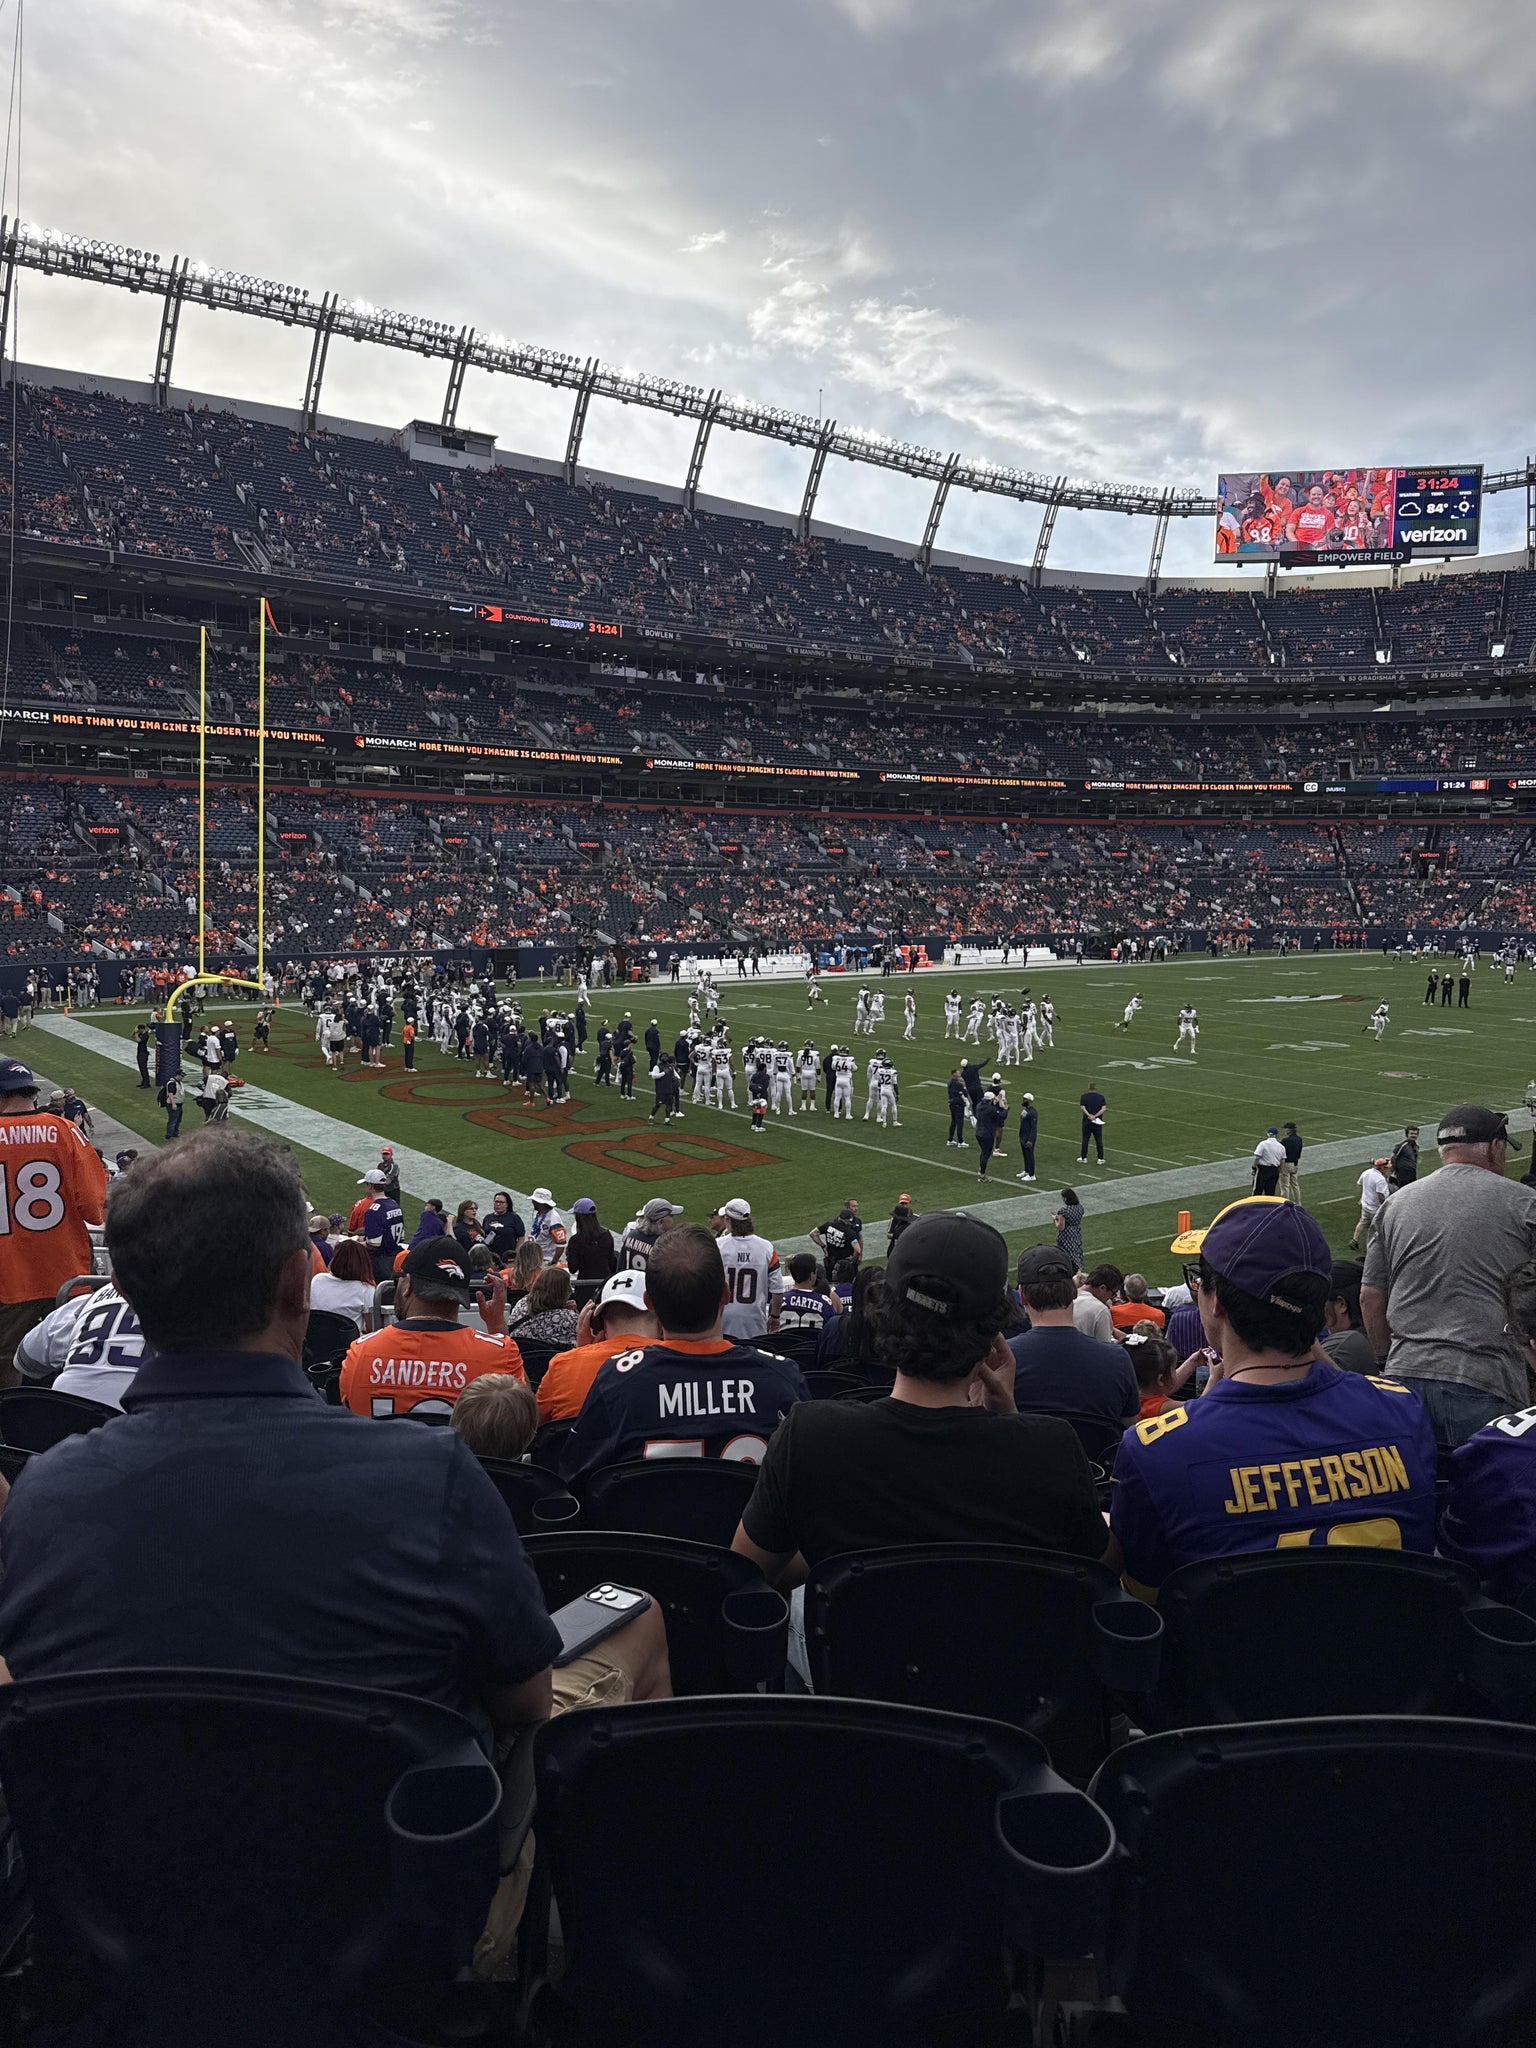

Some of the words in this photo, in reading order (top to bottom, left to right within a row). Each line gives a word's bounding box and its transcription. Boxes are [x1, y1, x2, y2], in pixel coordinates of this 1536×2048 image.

[1417, 478, 1459, 490] 31:24
[1400, 526, 1467, 543] verizon
[1318, 552, 1371, 562] EMPOWER
[1374, 552, 1404, 561] FIELD
[506, 612, 541, 624] COUNTDOWN
[588, 622, 618, 635] 31:24
[644, 629, 674, 640] BOWLEN
[744, 642, 768, 650] THOMAS
[800, 648, 826, 657] MANNING
[986, 666, 1015, 675] UPCHURCH
[53, 714, 83, 725] MORE
[85, 716, 114, 727] THAN
[117, 718, 138, 729] YOU
[140, 720, 188, 732] IMAGINE
[190, 724, 201, 733] IS
[204, 726, 242, 736] CLOSER
[244, 728, 269, 738] THAN
[270, 730, 290, 740] YOU
[366, 737, 416, 748] MONARCH
[419, 742, 442, 752] MORE
[444, 744, 465, 753] THAN
[466, 746, 482, 754] YOU
[484, 747, 519, 758] IMAGINE
[520, 750, 530, 758] IS
[531, 751, 560, 760] CLOSER
[561, 753, 580, 762] THAN
[582, 754, 597, 763] YOU
[654, 760, 694, 768] MONARCH
[695, 762, 714, 770] MORE
[715, 764, 732, 772] THAN
[732, 764, 746, 772] YOU
[746, 766, 775, 774] IMAGINE
[784, 768, 808, 776] CLOSER
[809, 769, 826, 777] THAN
[826, 770, 838, 778] YOU
[886, 772, 920, 780] MONARCH
[922, 775, 937, 783] MORE
[938, 776, 953, 784] THAN
[88, 826, 120, 835] verizon
[280, 832, 307, 840] verizon
[1264, 1040, 1351, 1051] 30
[715, 1054, 728, 1064] 53
[760, 1053, 772, 1064] 98
[1097, 1056, 1198, 1070] 20
[836, 1060, 848, 1072] 64
[880, 1074, 892, 1085] 32
[0, 1125, 58, 1146] ANNING
[737, 1252, 750, 1263] NIX
[726, 1267, 758, 1304] 10
[790, 1296, 824, 1312] CARTER
[370, 1357, 468, 1389] SANDERS
[658, 1379, 756, 1418] MILLER
[1224, 1445, 1410, 1515] JEFFERSON
